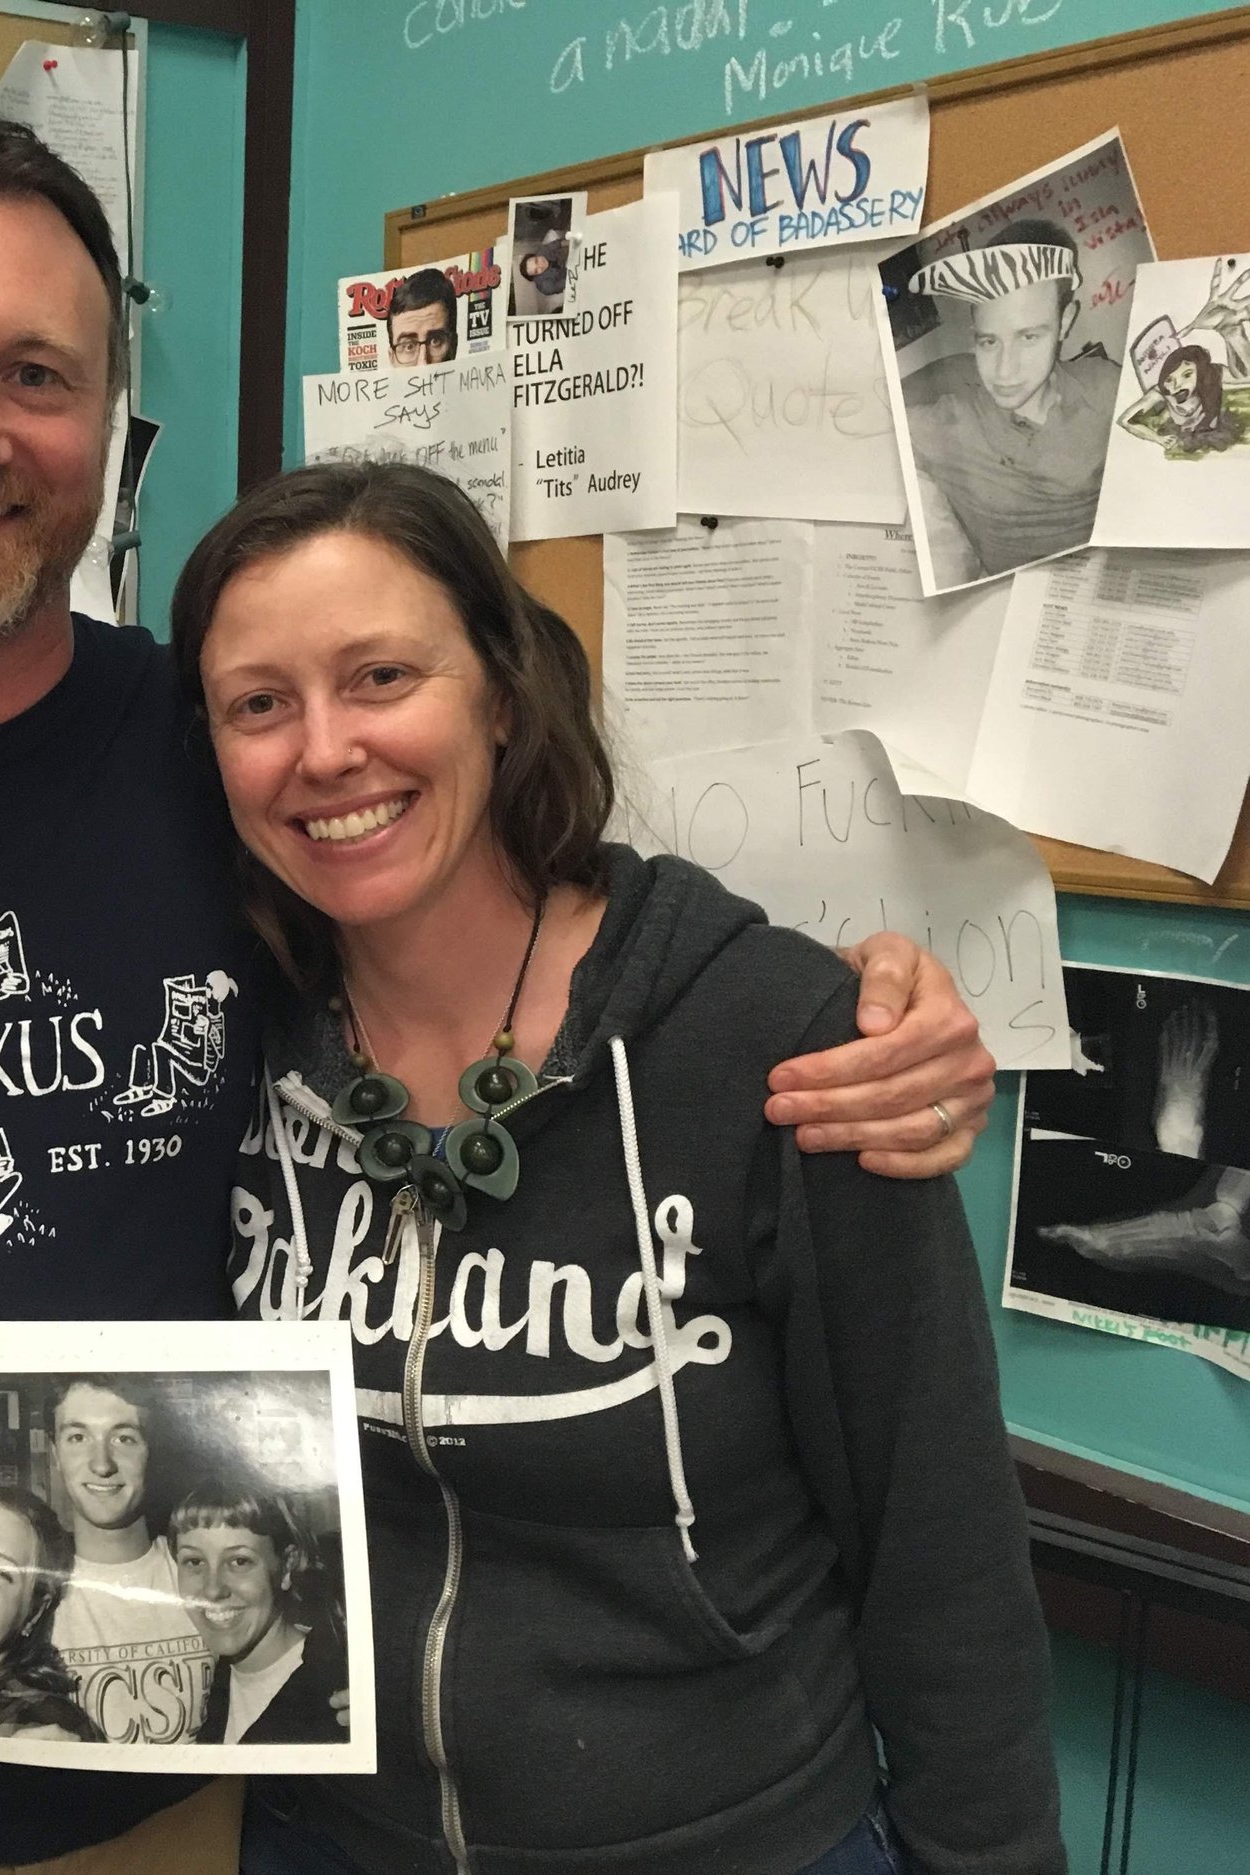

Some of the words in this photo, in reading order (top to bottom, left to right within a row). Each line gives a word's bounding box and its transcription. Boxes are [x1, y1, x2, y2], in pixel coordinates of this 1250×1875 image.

[724, 18, 903, 115] Monique
[700, 118, 871, 227] NEWS
[730, 216, 769, 247] OF
[779, 186, 924, 247] BADASSERY
[584, 242, 608, 271] HE
[469, 309, 490, 328] TV
[513, 310, 594, 346] TURNED
[598, 300, 633, 331] OFF
[347, 330, 377, 341] INSIDE
[348, 344, 377, 357] KOCH
[349, 360, 378, 371] TOXIC
[513, 348, 563, 378] ELLA
[318, 377, 390, 407] MORE
[459, 364, 507, 392] MAURA
[513, 363, 644, 408] FITZGERALD?!
[536, 445, 585, 469] Letitia
[536, 474, 579, 498] “Tits”
[587, 469, 641, 494] Audrey
[48, 1145, 111, 1174] EST.
[125, 1135, 183, 1164] 1930
[227, 1181, 733, 1366] Oakland
[68, 1648, 111, 1664] RSITY
[118, 1647, 140, 1660] OF
[145, 1638, 203, 1657] CALIFO
